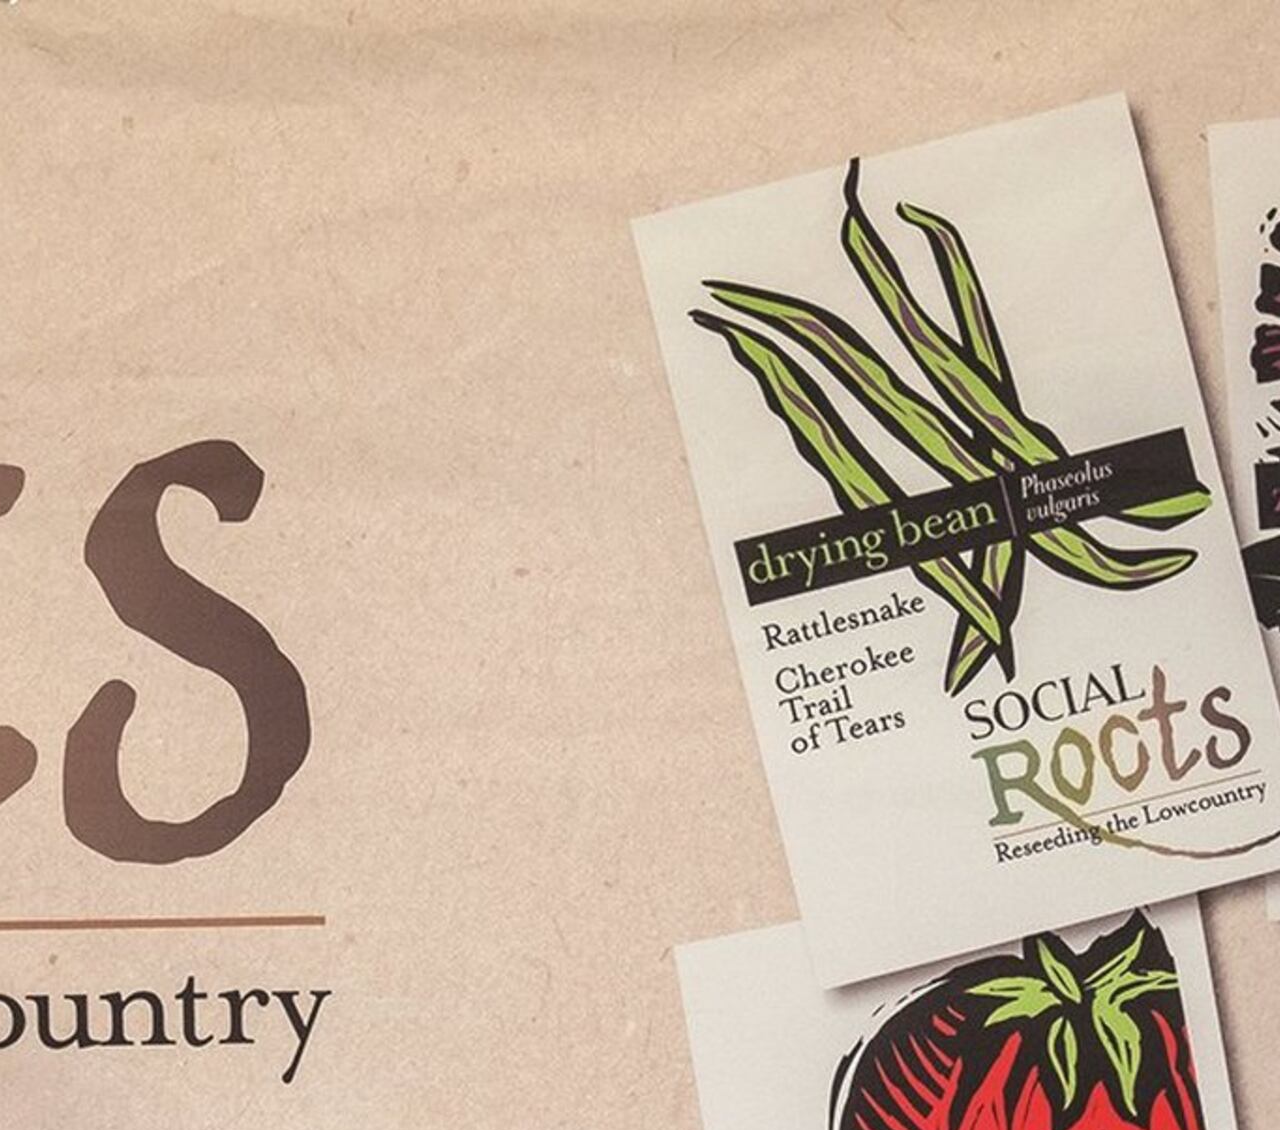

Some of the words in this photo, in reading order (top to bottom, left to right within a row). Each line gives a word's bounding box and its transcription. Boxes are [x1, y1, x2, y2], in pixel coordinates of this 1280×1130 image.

[1021, 461, 1113, 498] Phaseolus
[1027, 488, 1102, 522] vulgaris
[747, 529, 887, 591] drying
[892, 497, 997, 550] bean
[763, 592, 926, 651] Rattlesnake
[776, 642, 915, 696] Cherokee
[779, 687, 853, 727] Trail
[964, 664, 1145, 742] SOCIAL
[791, 721, 826, 755] of
[831, 707, 906, 744] Tears
[995, 822, 1102, 865] Reseeding
[1106, 810, 1139, 835] the
[1141, 780, 1268, 824] Lowcountry
